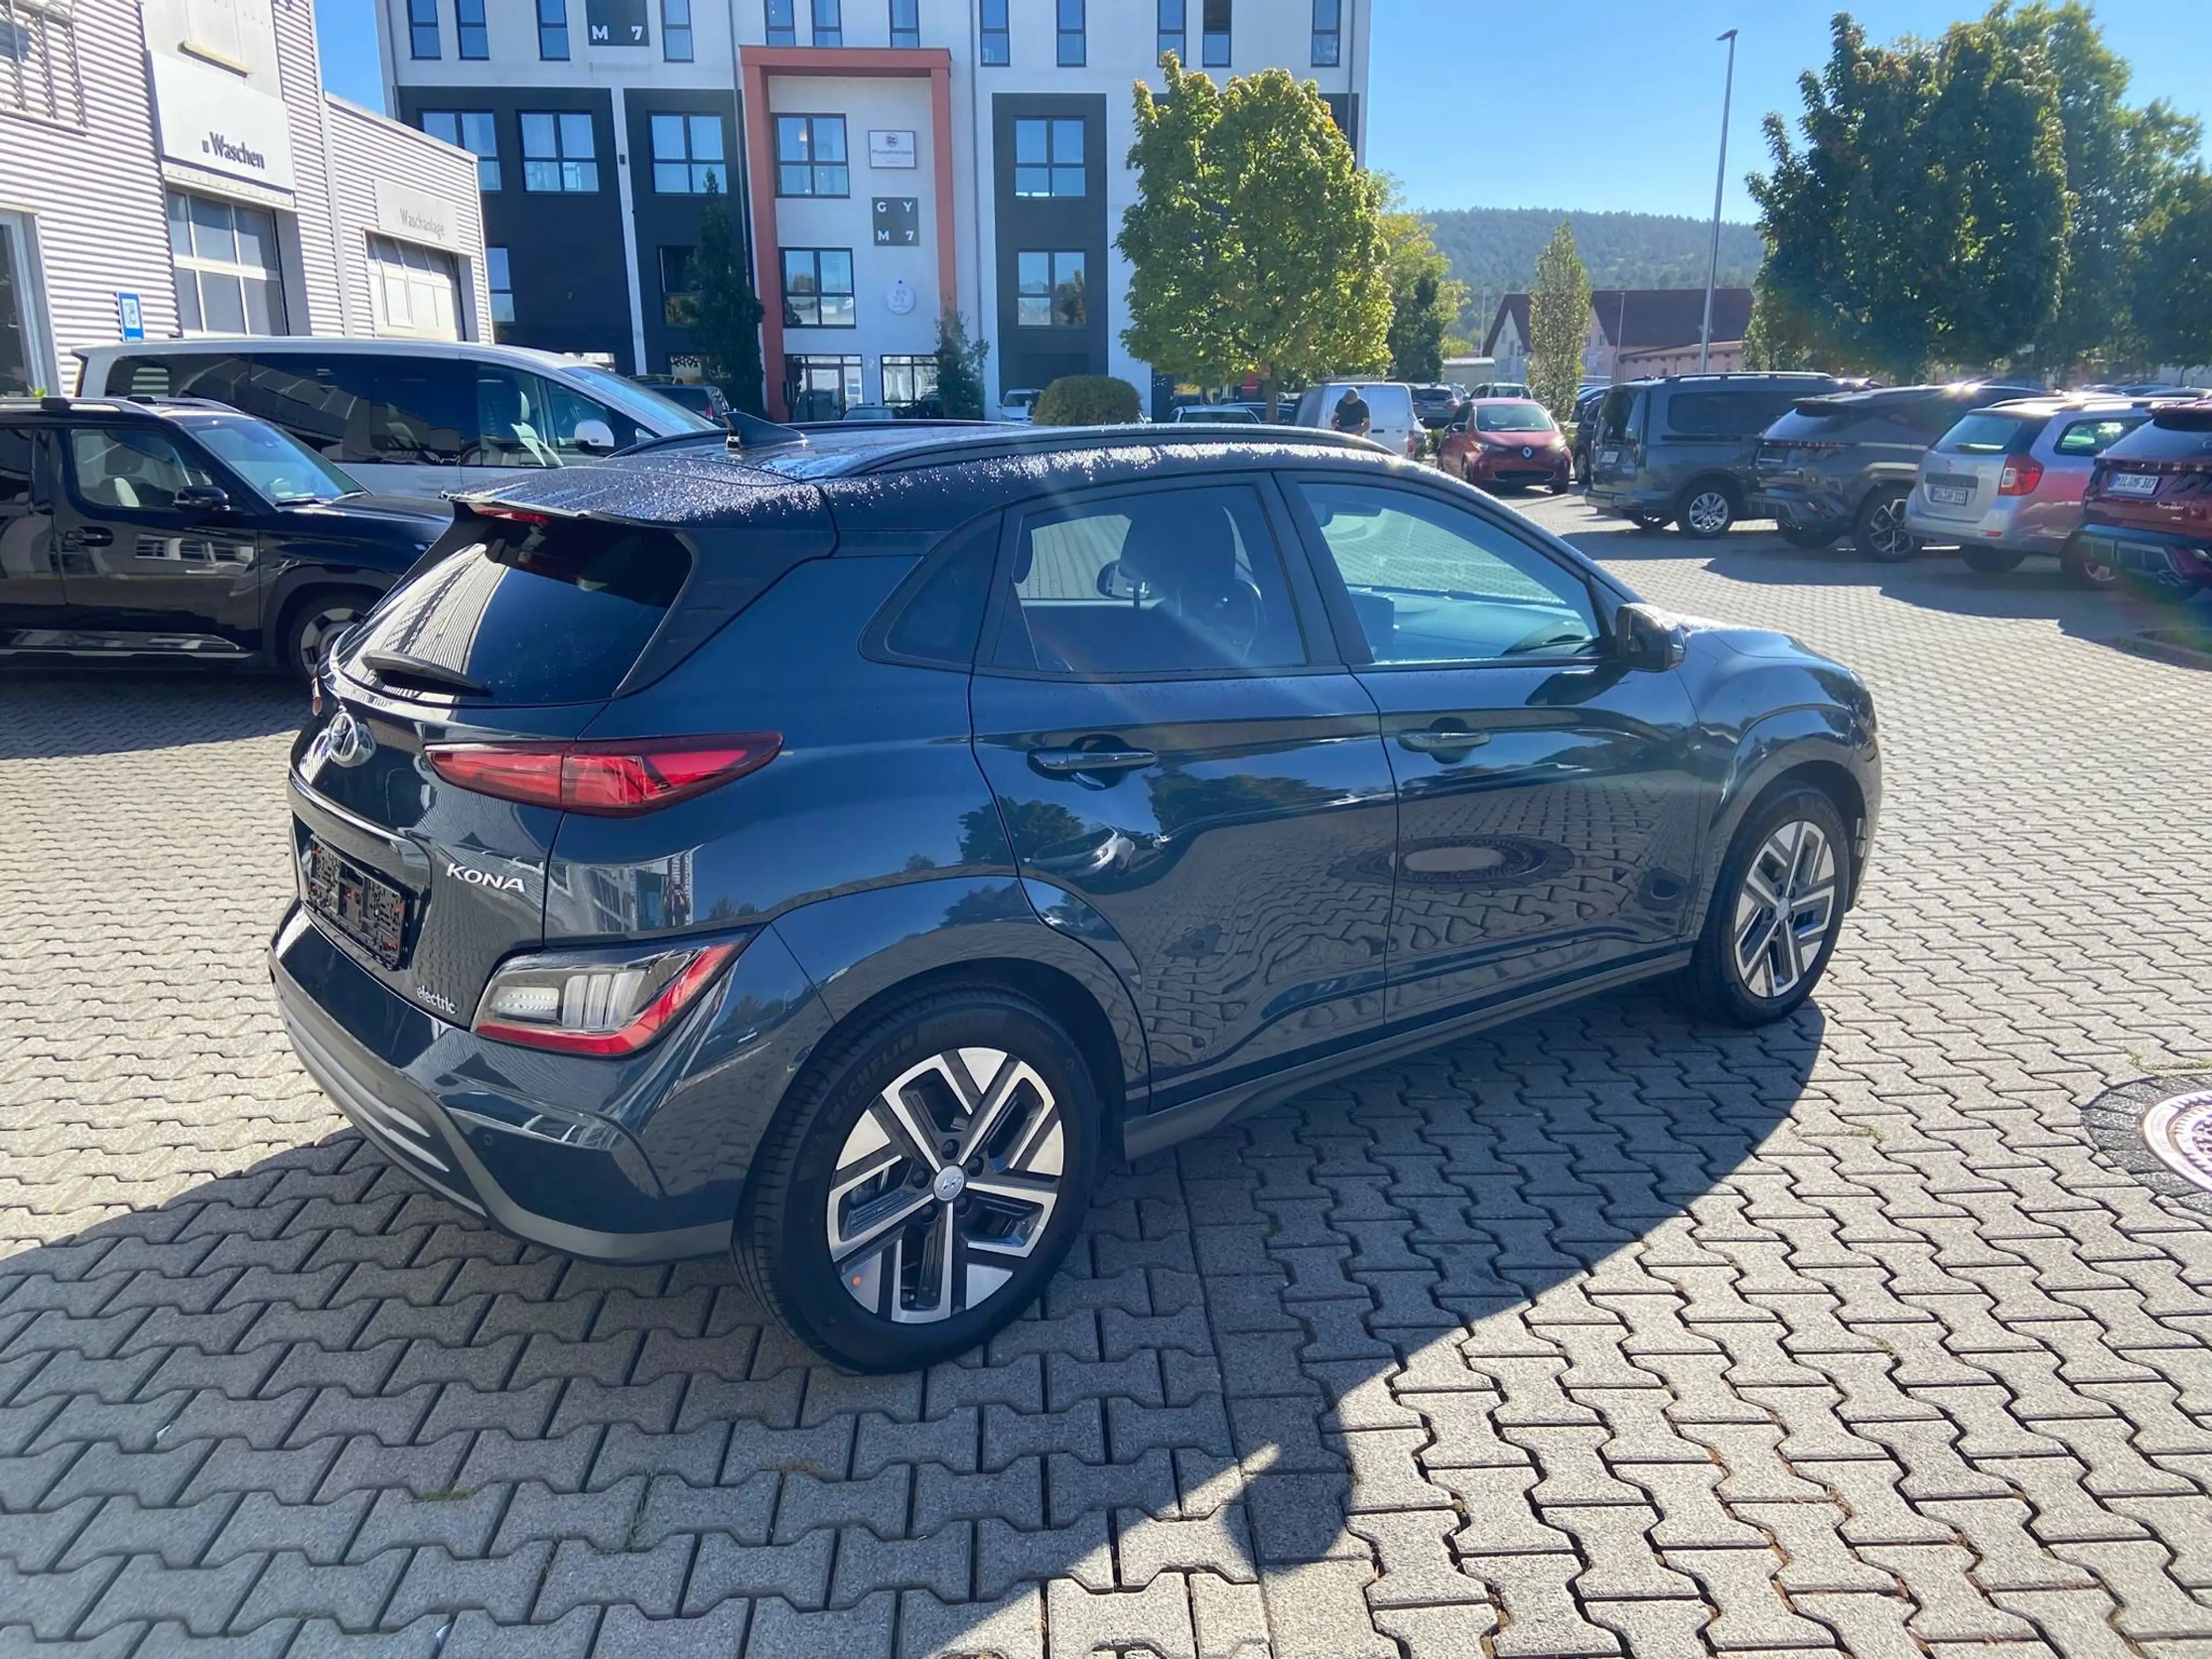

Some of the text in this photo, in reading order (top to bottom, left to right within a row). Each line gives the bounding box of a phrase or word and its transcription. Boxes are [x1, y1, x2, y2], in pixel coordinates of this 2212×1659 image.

[592, 25, 643, 40] M 7
[209, 131, 265, 169] Waschen
[877, 202, 912, 213] G Y
[399, 207, 445, 240] Waschanlage
[877, 230, 914, 241] M 7
[446, 863, 525, 892] KONA
[416, 984, 456, 1014] electric
